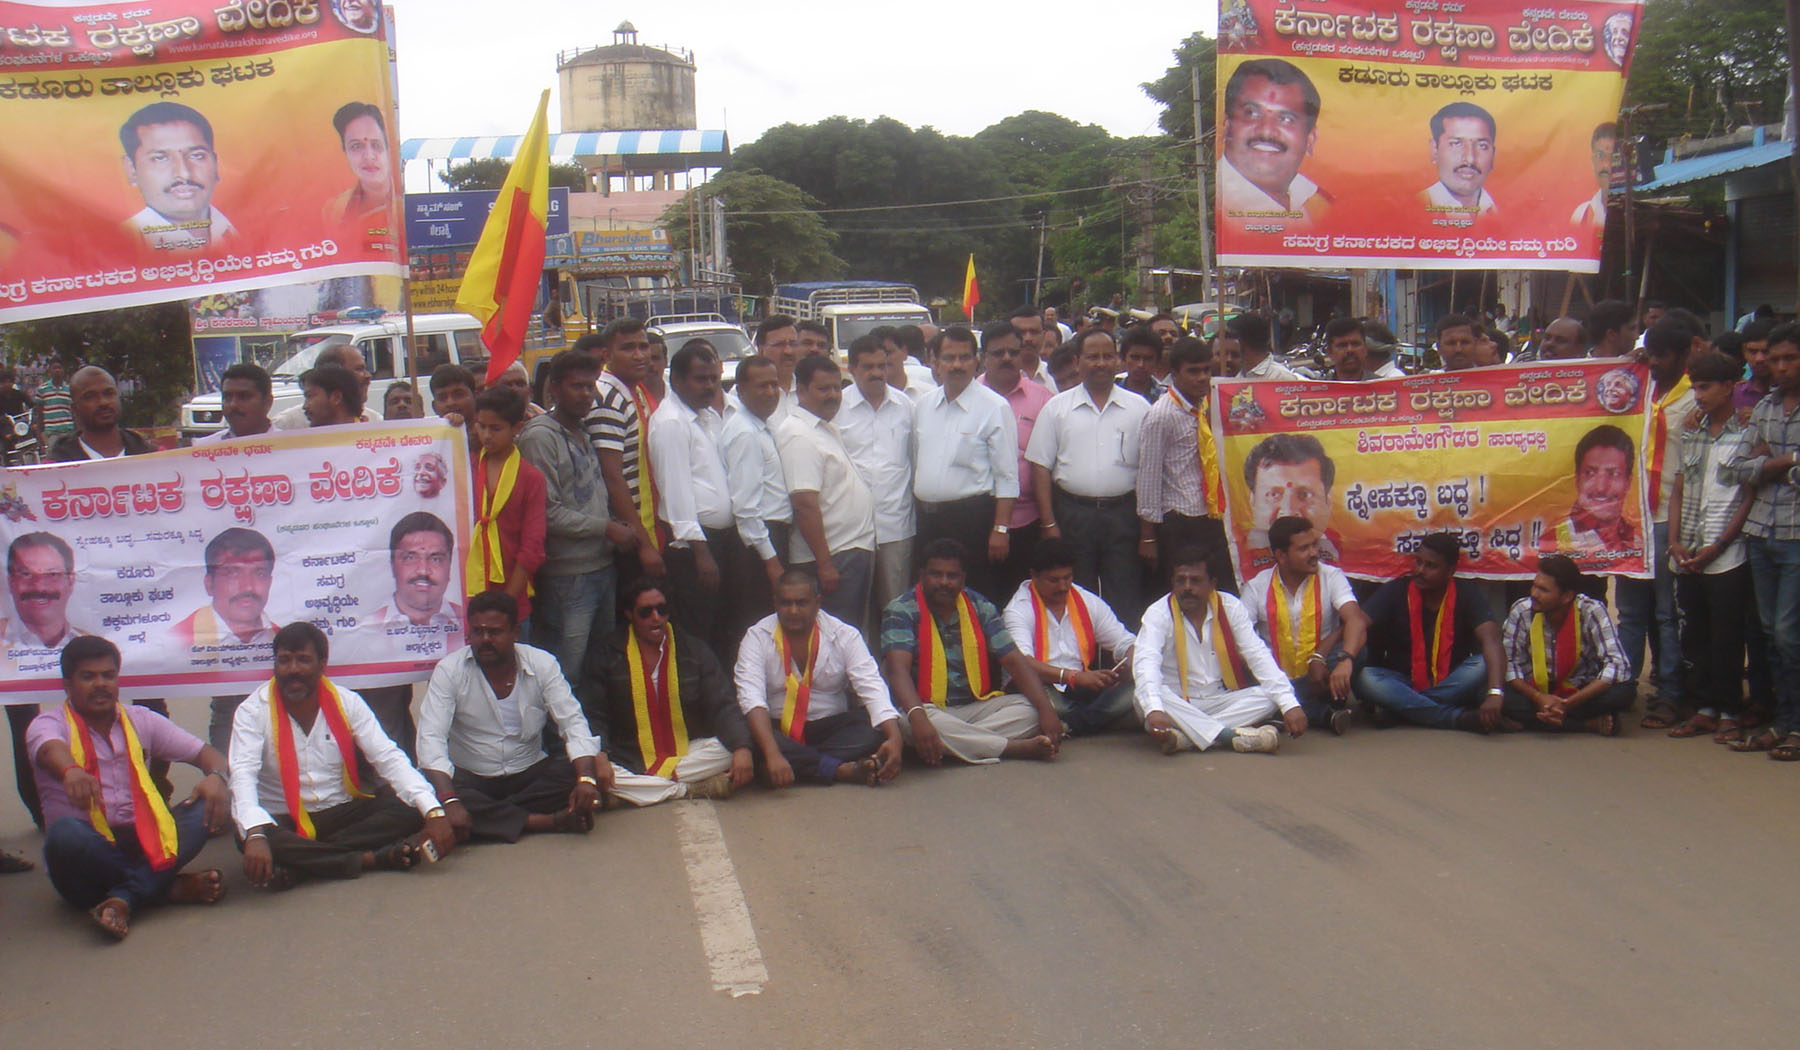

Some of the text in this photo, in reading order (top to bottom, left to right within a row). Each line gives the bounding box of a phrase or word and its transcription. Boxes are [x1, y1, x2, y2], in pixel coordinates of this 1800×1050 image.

[0, 22, 71, 47] ಟಕ
[87, 17, 200, 56] ರಕ್ಷಣಾ
[1274, 4, 1595, 61] ಕರ್ನಾಟಕ ರಕ್ಷಣಾ ವೇದಿಕೆ
[0, 57, 276, 99] ಕಡೂರು ತಾಲ್ಲೂಕು ಘಟಕ
[1338, 64, 1553, 96] ಕಡೂರು ತಾಲ್ಲೂಕು ಘಟಕ
[1283, 234, 1330, 252] ಸಮಗ್ರ
[1333, 234, 1415, 249] ಕರ್ನಾಟಕದ
[1419, 236, 1507, 257] ಅಭಿವೃದ್ಧಿಯೇ
[1510, 238, 1547, 257] ನಮ್ಮ
[1547, 237, 1577, 251] ಗುರಿ
[31, 266, 137, 294] ಕರ್ನಾಟಕದ
[141, 254, 253, 284] ಅಭಿವೃದ್ಧಿಯೇ
[256, 248, 303, 270] ನಮ್ಮ
[300, 239, 338, 261] ಗುರಿ
[1279, 379, 1587, 418] ಕರ್ನಾಟಕ ರಕ್ಷಣಾ ವೇದಿಕೆ
[192, 443, 273, 461] ಕನ್ನಡವೇ ಧರ್ಮ
[356, 435, 432, 453] ಕನ್ನಡವೇ ದೇವರು
[1357, 425, 1479, 453] ಶಿವರಾಮೇಗೌಡರ
[42, 457, 402, 525] ಕರ್ನಾಟಕ ರಕ್ಷಣಾ ವೇದಿಕೆ
[1347, 482, 1428, 520] ಸ್ನೇಹಕ್ಕೂ
[117, 565, 155, 579] ಕಡೂರು
[302, 552, 356, 567] ಕರ್ನಾಟಕದ
[148, 587, 174, 603] ಘಟಕ
[316, 573, 345, 589] ಸಮಗ್ರ
[336, 616, 357, 628] ಗುರಿ
